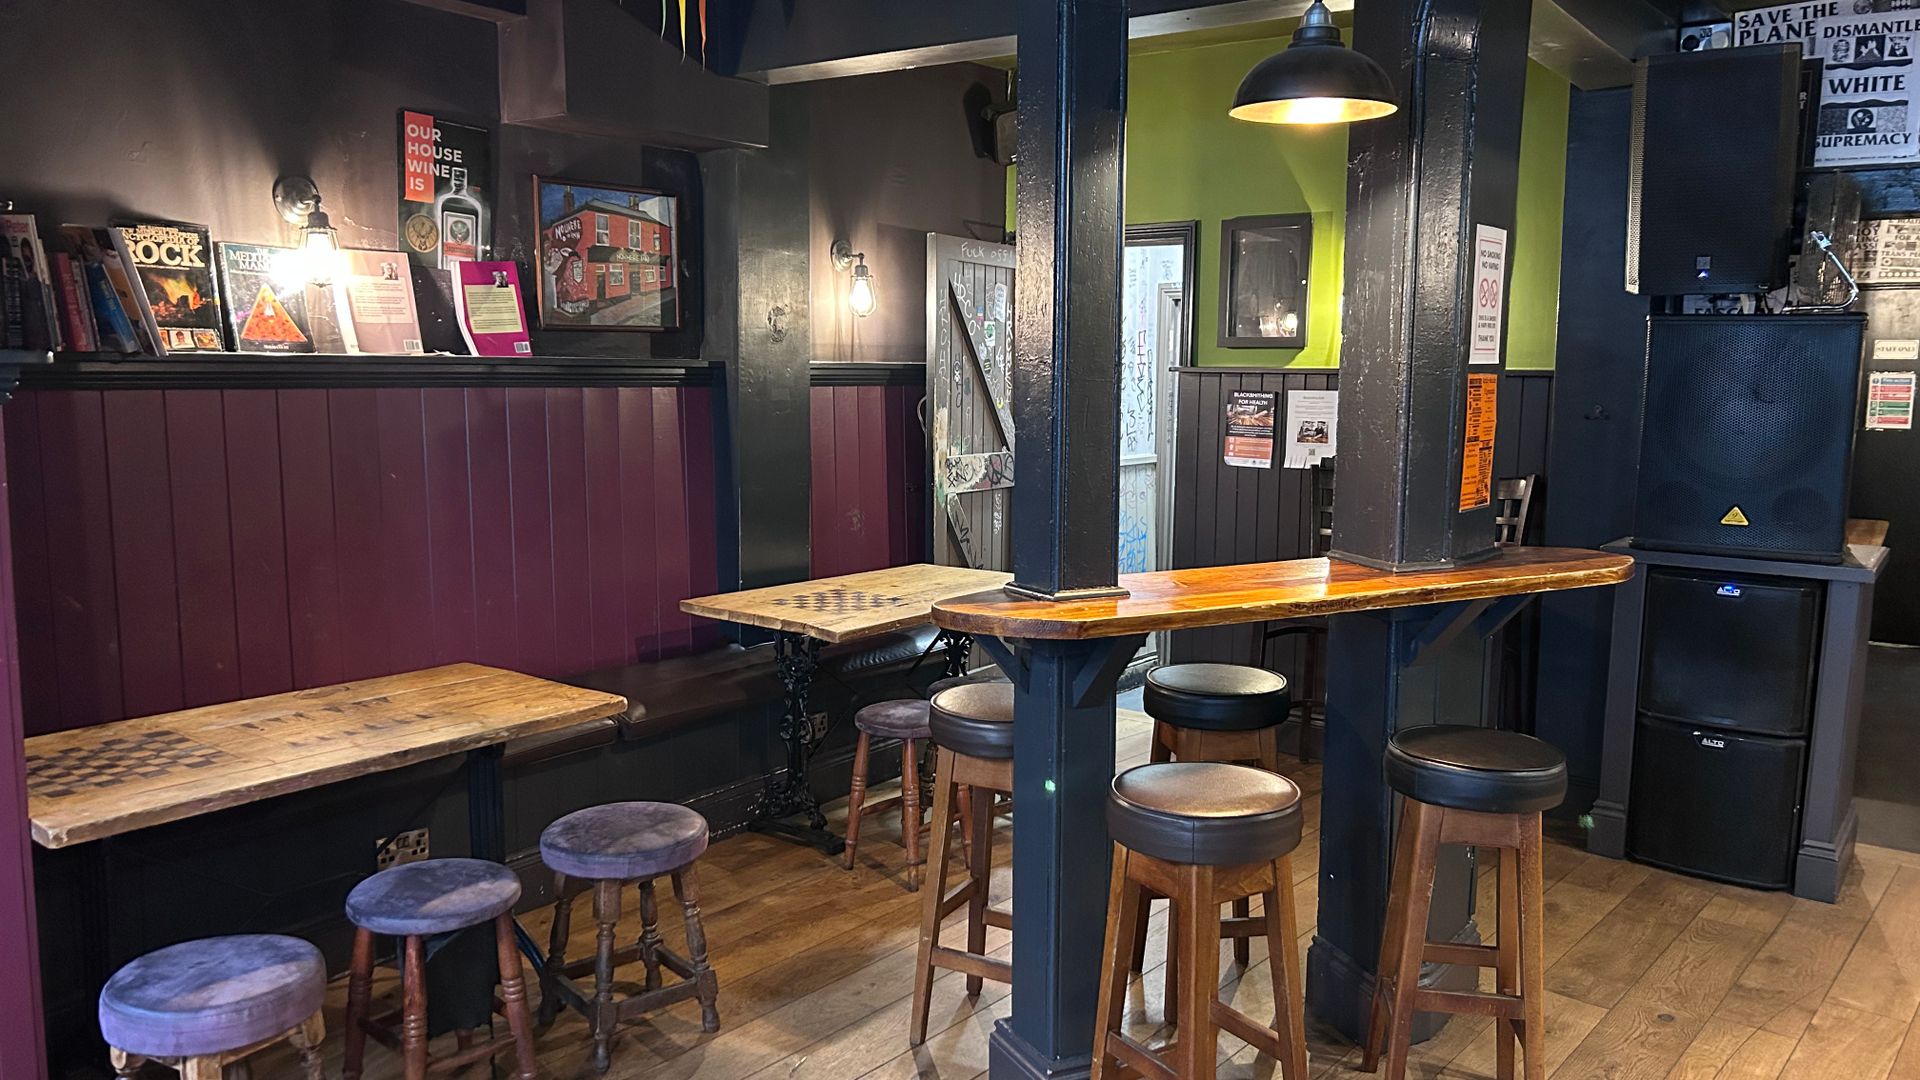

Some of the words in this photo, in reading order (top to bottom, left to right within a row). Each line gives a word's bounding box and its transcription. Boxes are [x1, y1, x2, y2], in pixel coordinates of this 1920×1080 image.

[1739, 8, 1791, 29] SAVE
[1800, 2, 1839, 20] THE
[1823, 19, 1920, 39] DISMANTLE
[1829, 74, 1906, 94] WHITE
[407, 124, 441, 142] OUR
[1815, 131, 1913, 148] SUPREMACY
[408, 141, 462, 163] HOUSE
[408, 158, 450, 178] WINE
[410, 176, 424, 191] IS
[1701, 737, 1725, 748] ALTO
